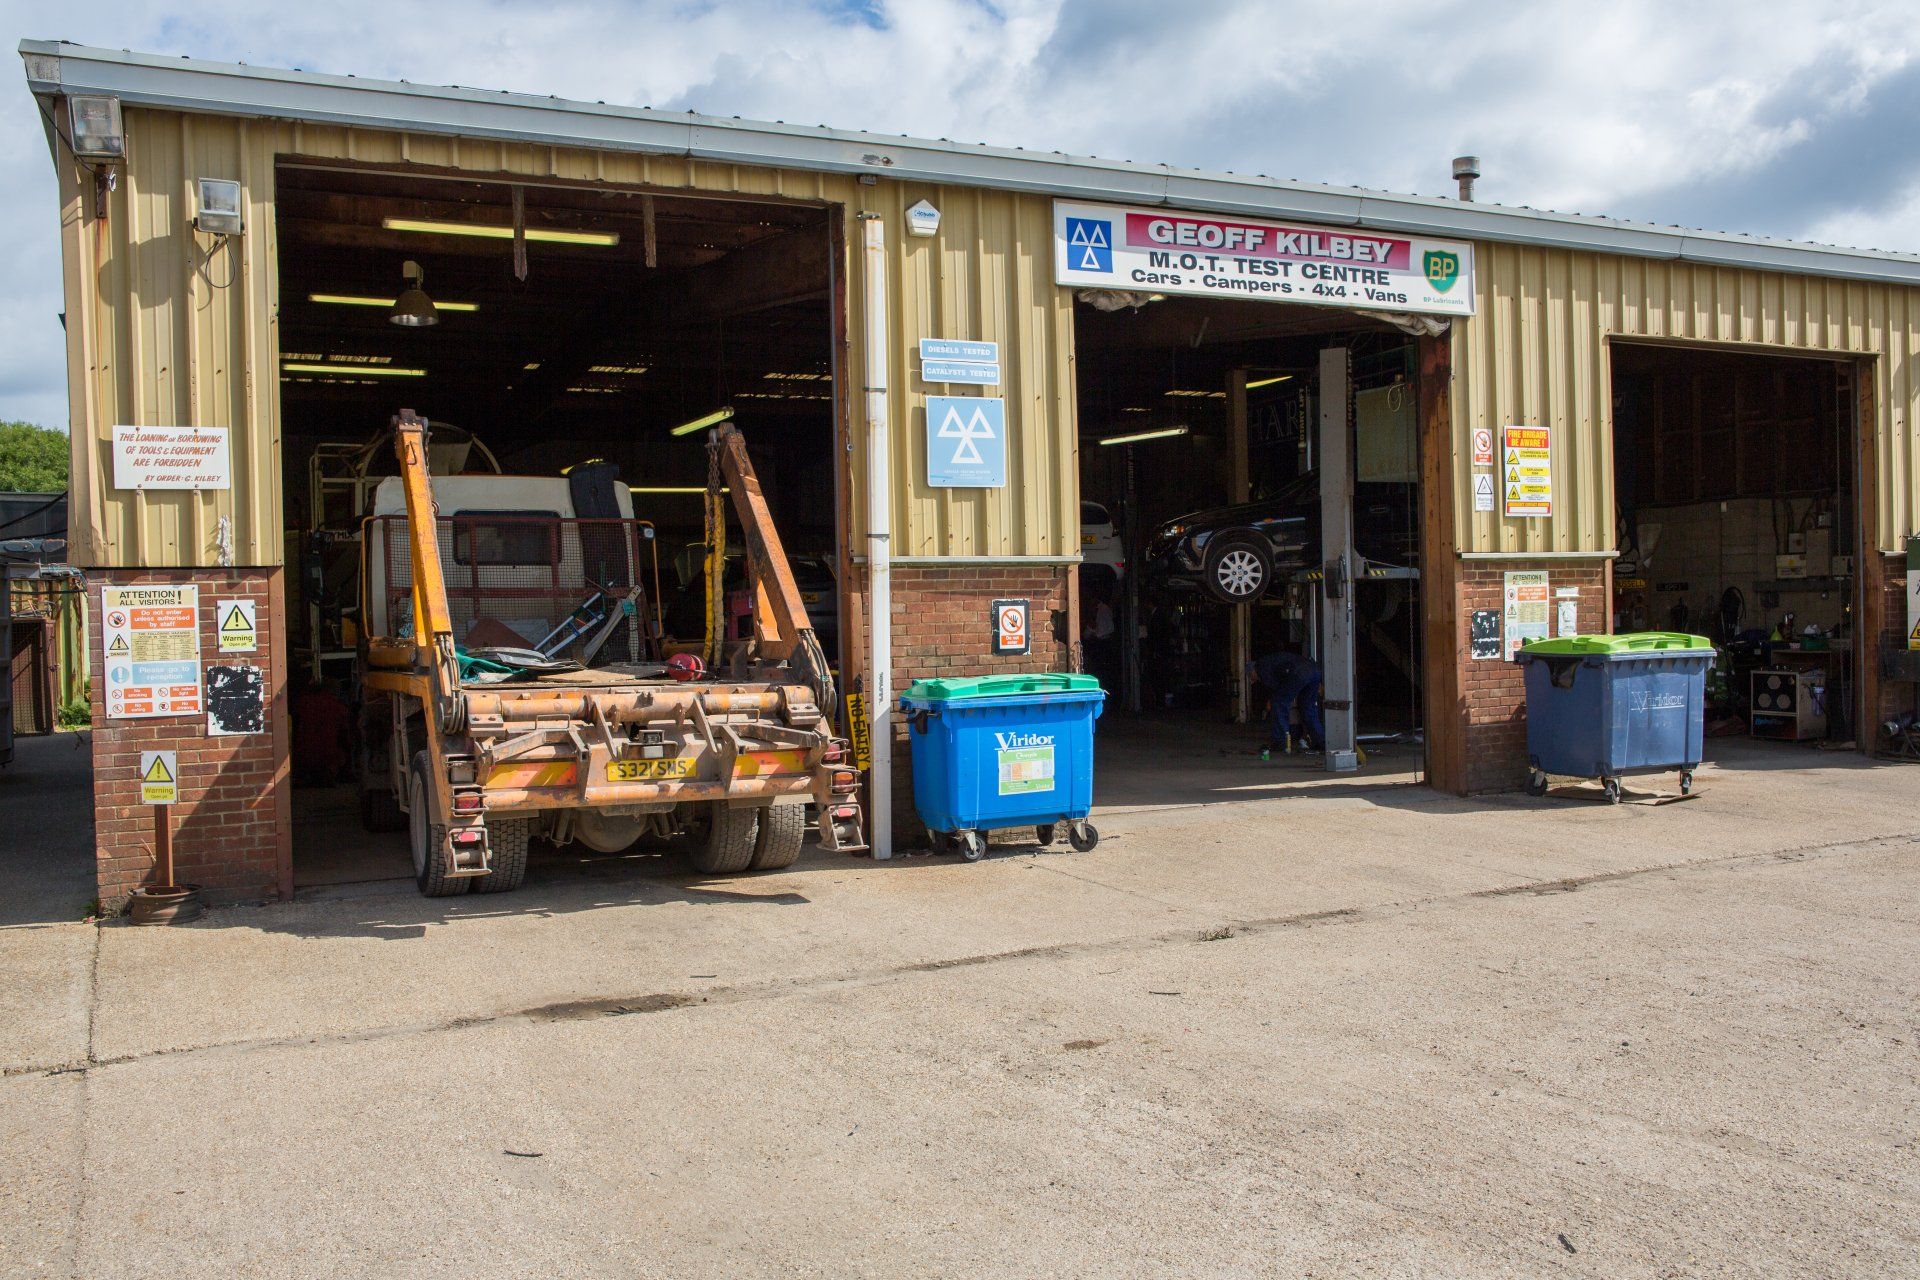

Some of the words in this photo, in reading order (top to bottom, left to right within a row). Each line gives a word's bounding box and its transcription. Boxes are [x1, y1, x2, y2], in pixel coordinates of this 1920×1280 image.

[1148, 220, 1265, 250] GEOFF
[1276, 232, 1392, 264] KILBEY
[1150, 252, 1224, 272] M.O.T.
[1234, 258, 1292, 277] TEST
[1302, 263, 1390, 286] CENTRE
[1429, 257, 1455, 280] BP
[1132, 269, 1182, 285] Cars
[1202, 274, 1292, 294] Campers
[1312, 284, 1346, 297] 4x4
[1365, 288, 1407, 304] Vans
[926, 368, 966, 376] CATALYSTS
[120, 433, 135, 442] THE
[136, 434, 168, 442] LOANING
[177, 434, 221, 443] BORROWING
[1508, 430, 1522, 438] FIRE
[1522, 430, 1547, 439] BRIGADE
[1520, 439, 1541, 447] AWARE
[126, 446, 136, 454] OF
[139, 446, 163, 454] TOOLS
[170, 446, 216, 455] EQUIPMENT
[994, 732, 1055, 752] Viridor
[618, 762, 652, 777] S321
[657, 760, 686, 776] SMS
